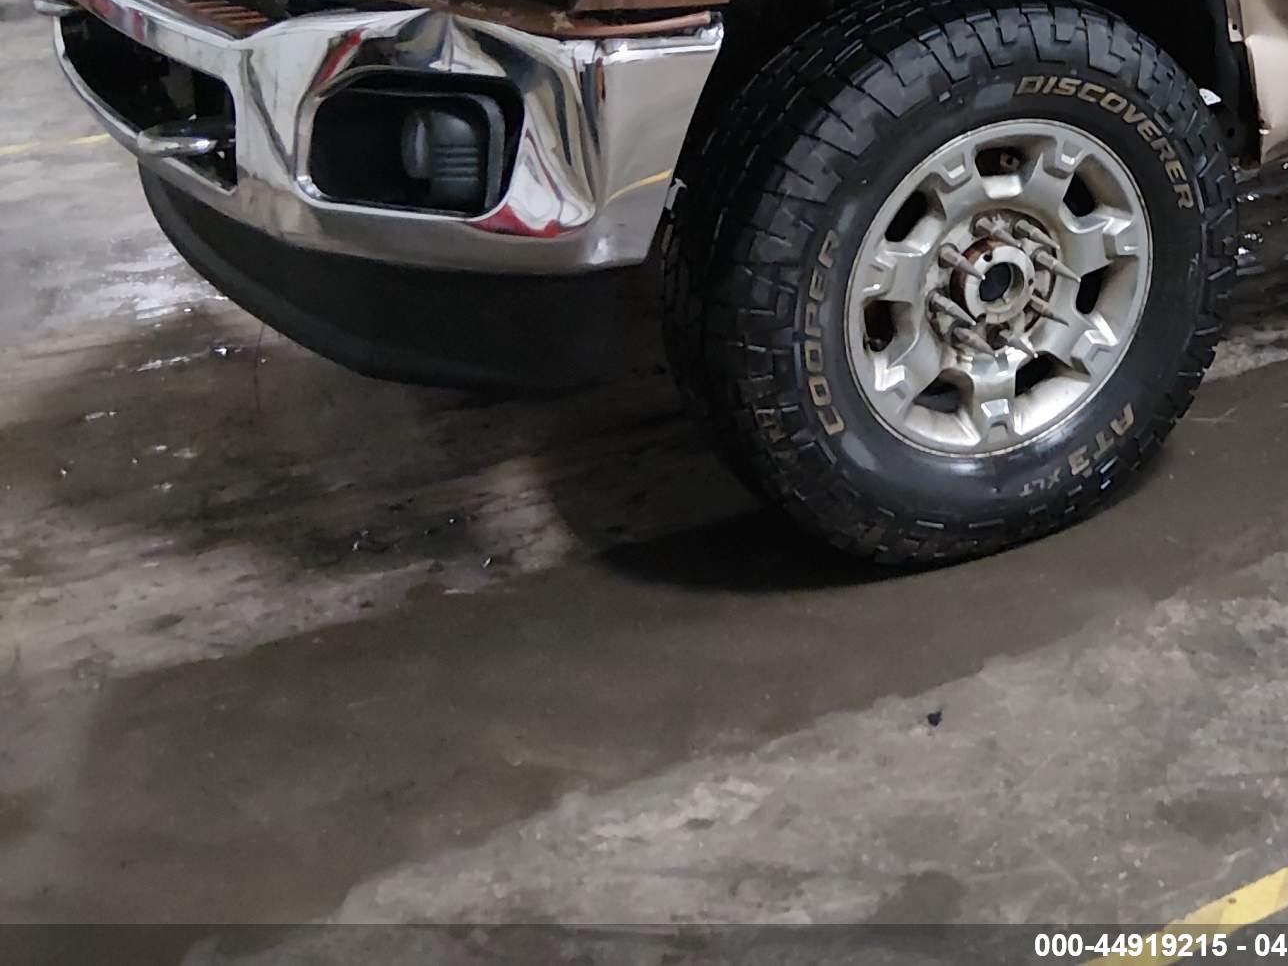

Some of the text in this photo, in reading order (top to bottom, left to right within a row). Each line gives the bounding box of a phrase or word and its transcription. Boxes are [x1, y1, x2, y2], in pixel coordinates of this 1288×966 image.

[1016, 75, 1195, 210] DISCOVERER
[804, 229, 845, 435] COOPER
[1019, 402, 1135, 497] AT3 XLT
